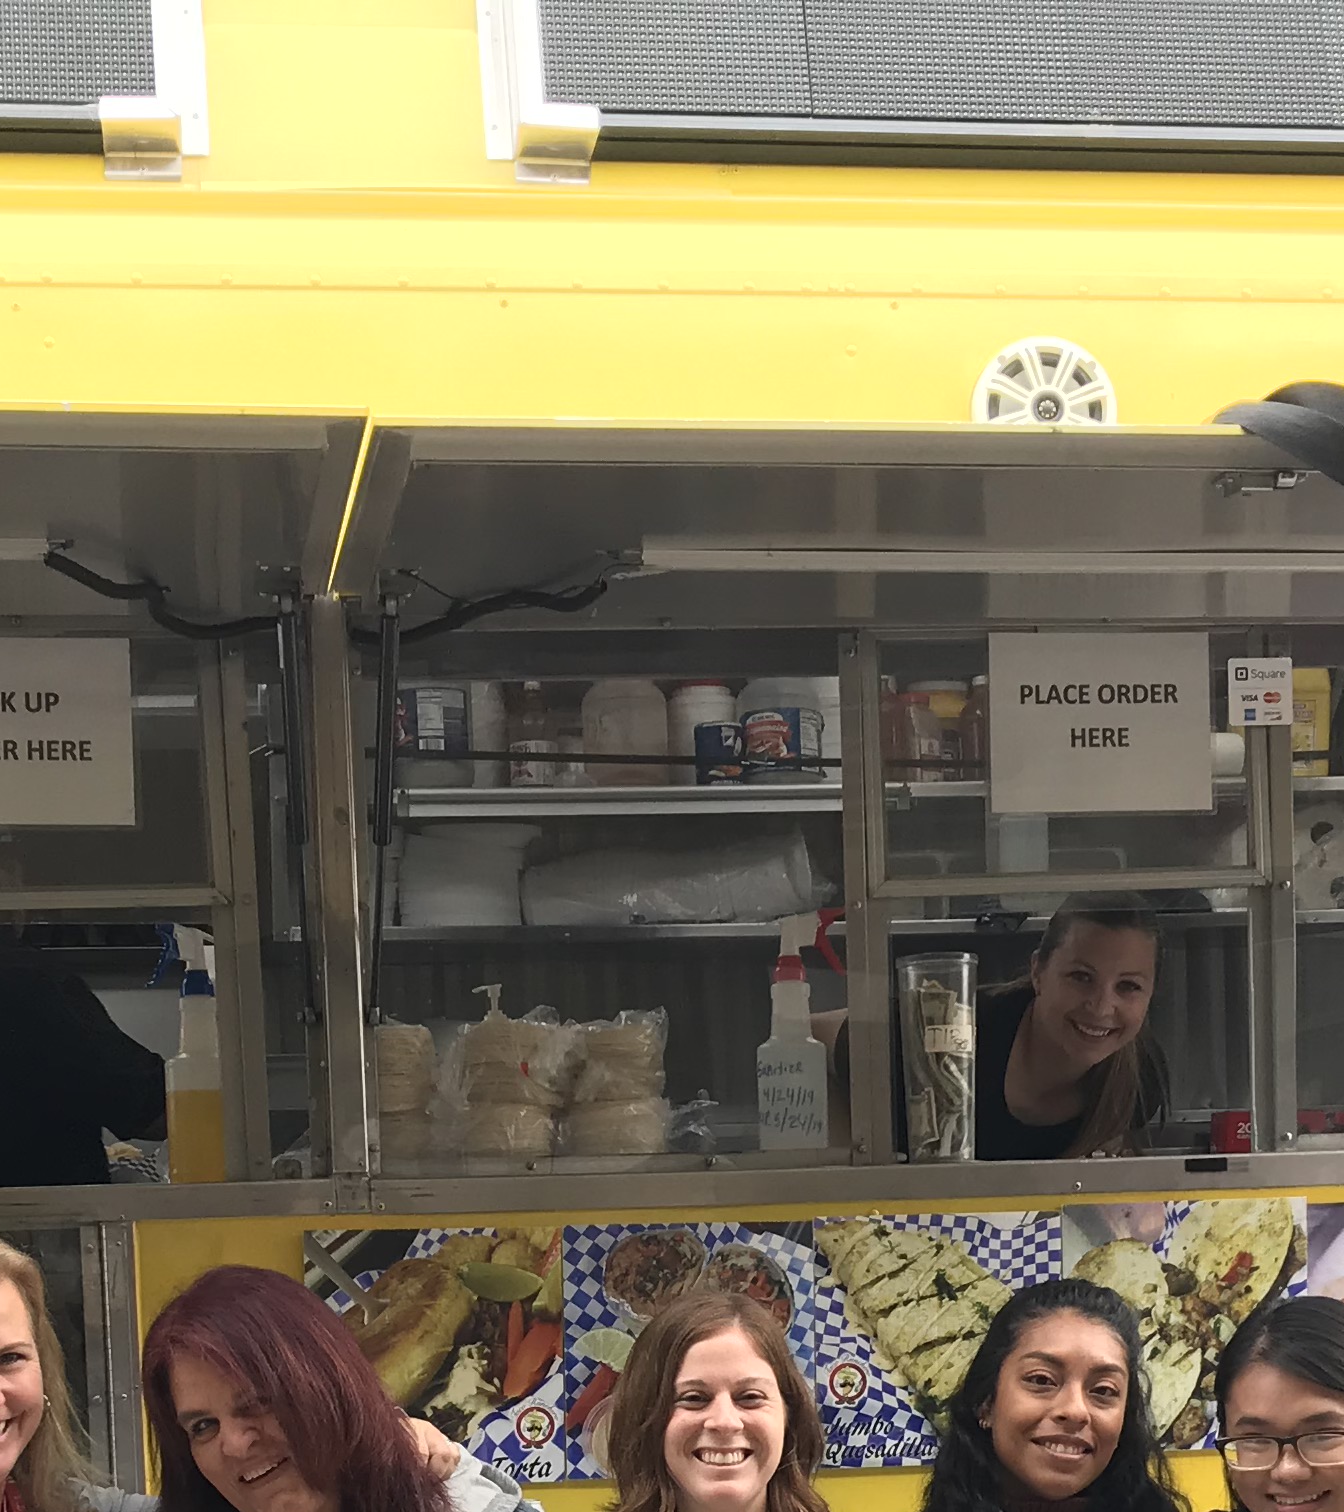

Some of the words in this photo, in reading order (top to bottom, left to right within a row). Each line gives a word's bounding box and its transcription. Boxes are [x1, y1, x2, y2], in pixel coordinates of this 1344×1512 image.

[1250, 668, 1286, 681] Square
[25, 692, 60, 713] UP
[1020, 684, 1090, 705] PLACE
[1098, 684, 1178, 705] ORDER
[1241, 694, 1258, 702] VISA
[1070, 727, 1130, 748] HERE
[27, 740, 92, 761] HERE
[824, 1415, 894, 1436] Jumbo
[825, 1437, 934, 1464] Quesadilla
